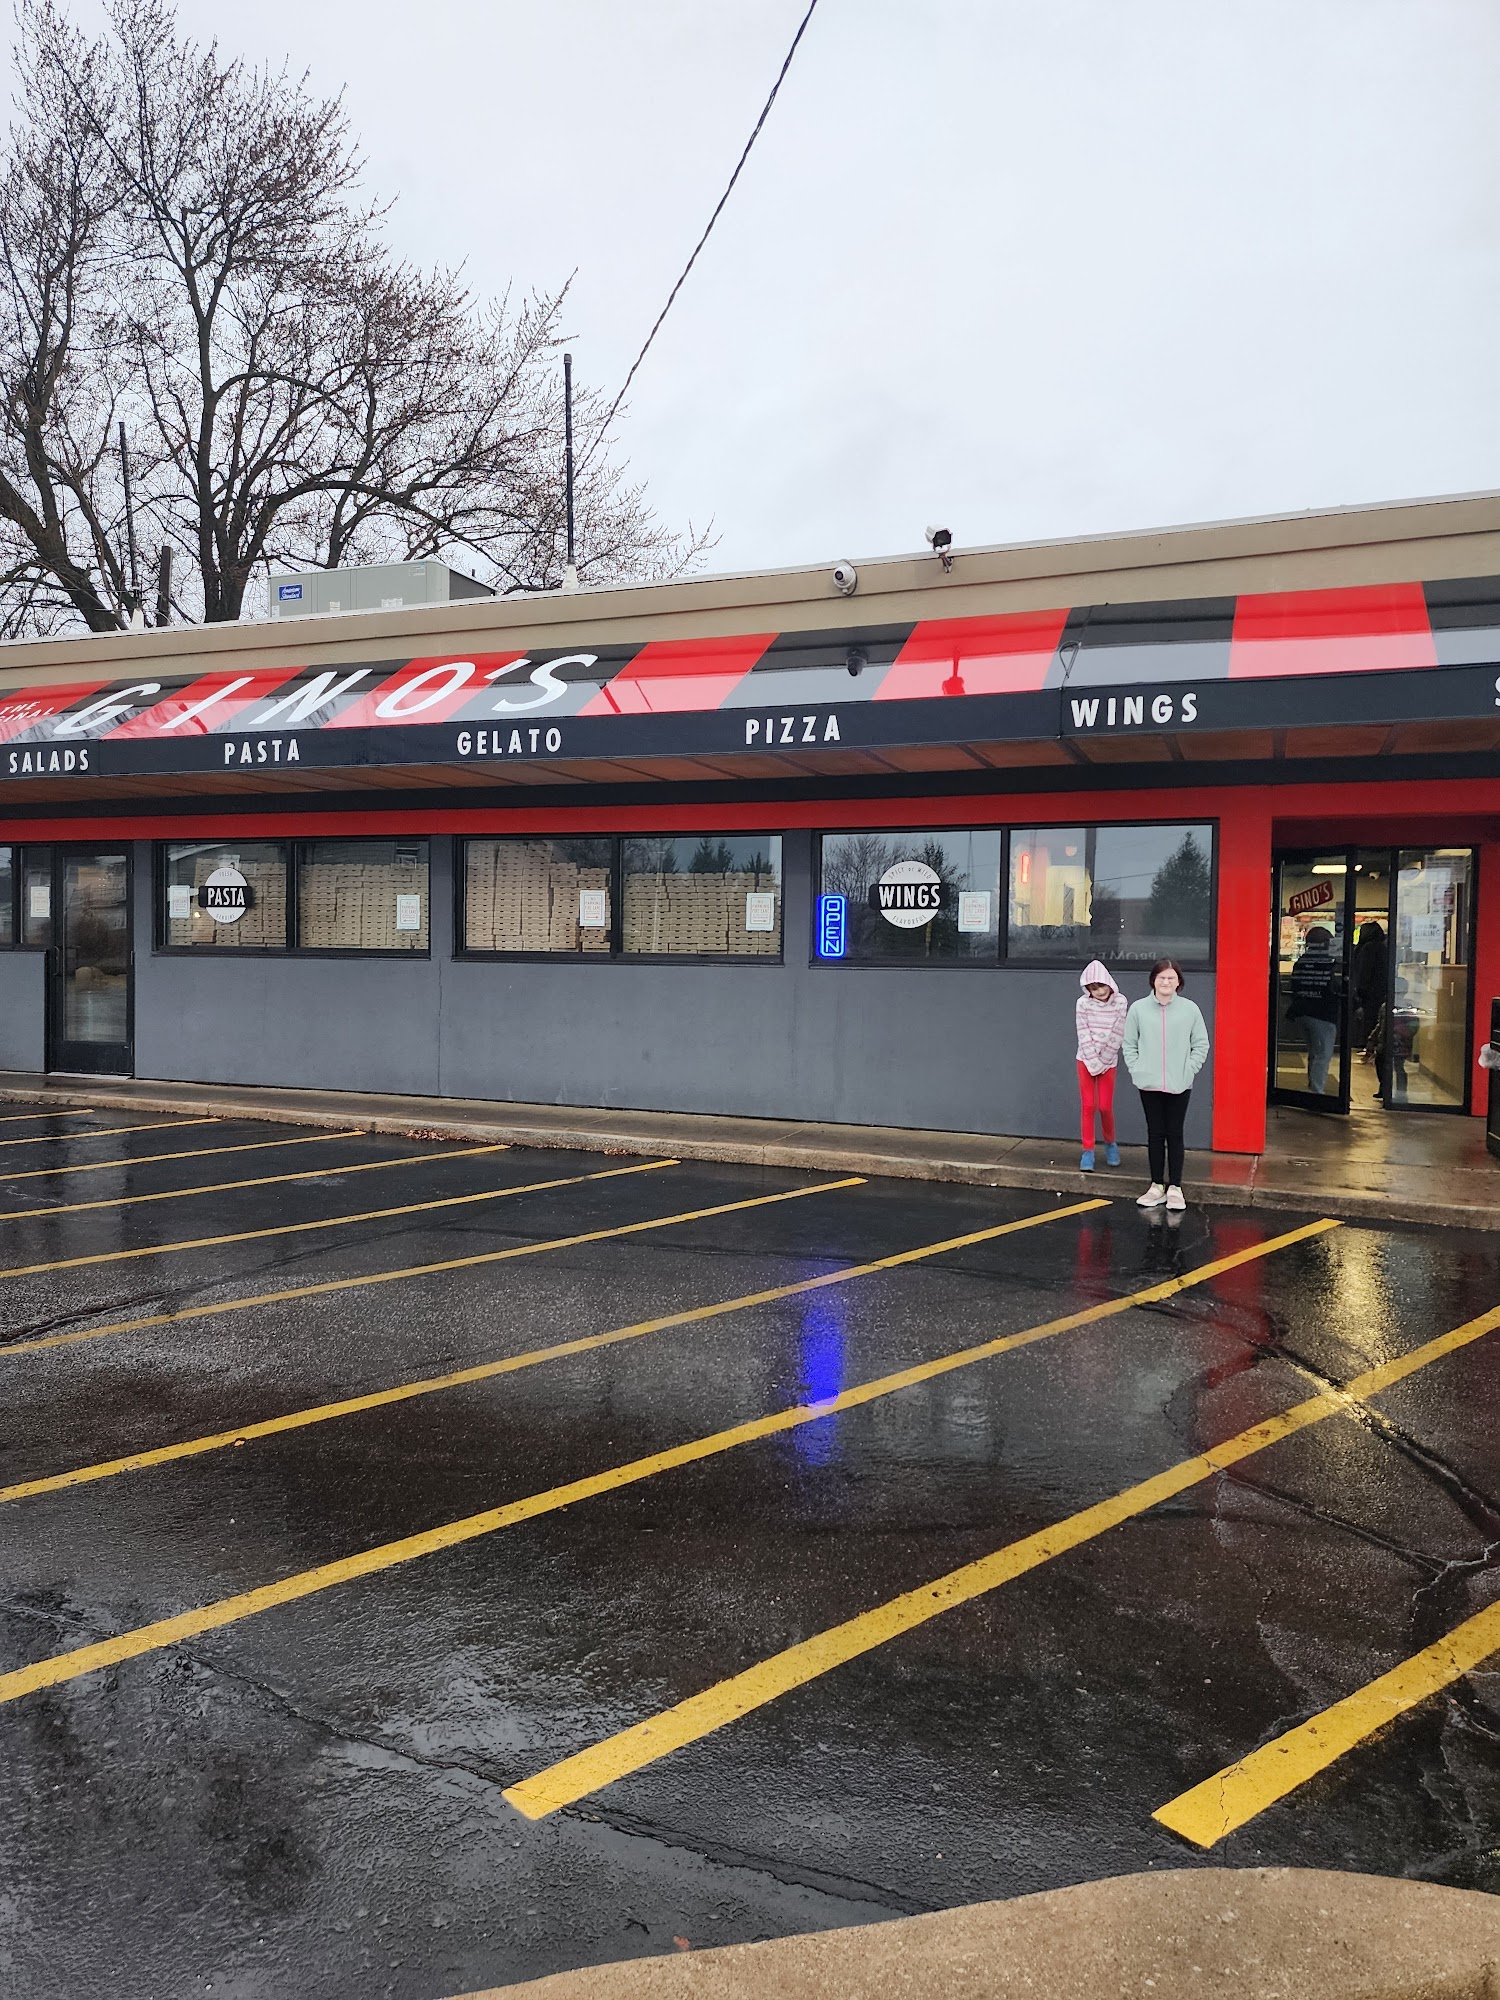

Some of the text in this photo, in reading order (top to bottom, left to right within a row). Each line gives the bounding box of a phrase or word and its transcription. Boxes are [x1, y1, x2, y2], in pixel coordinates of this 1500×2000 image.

[53, 654, 599, 735] GINO'S
[1071, 693, 1198, 728] WINGS
[457, 727, 562, 755] GELATO
[745, 715, 841, 744] PIZZA
[9, 749, 90, 773] SALADS
[224, 738, 300, 765] PASTA
[888, 867, 904, 879] SPICY
[917, 867, 932, 880] MILD
[207, 887, 245, 905] PASTA
[879, 885, 940, 907] WINGS
[1293, 883, 1330, 909] GINO'S
[826, 900, 840, 953] OPEN
[892, 914, 927, 925] FLAVORFUL
